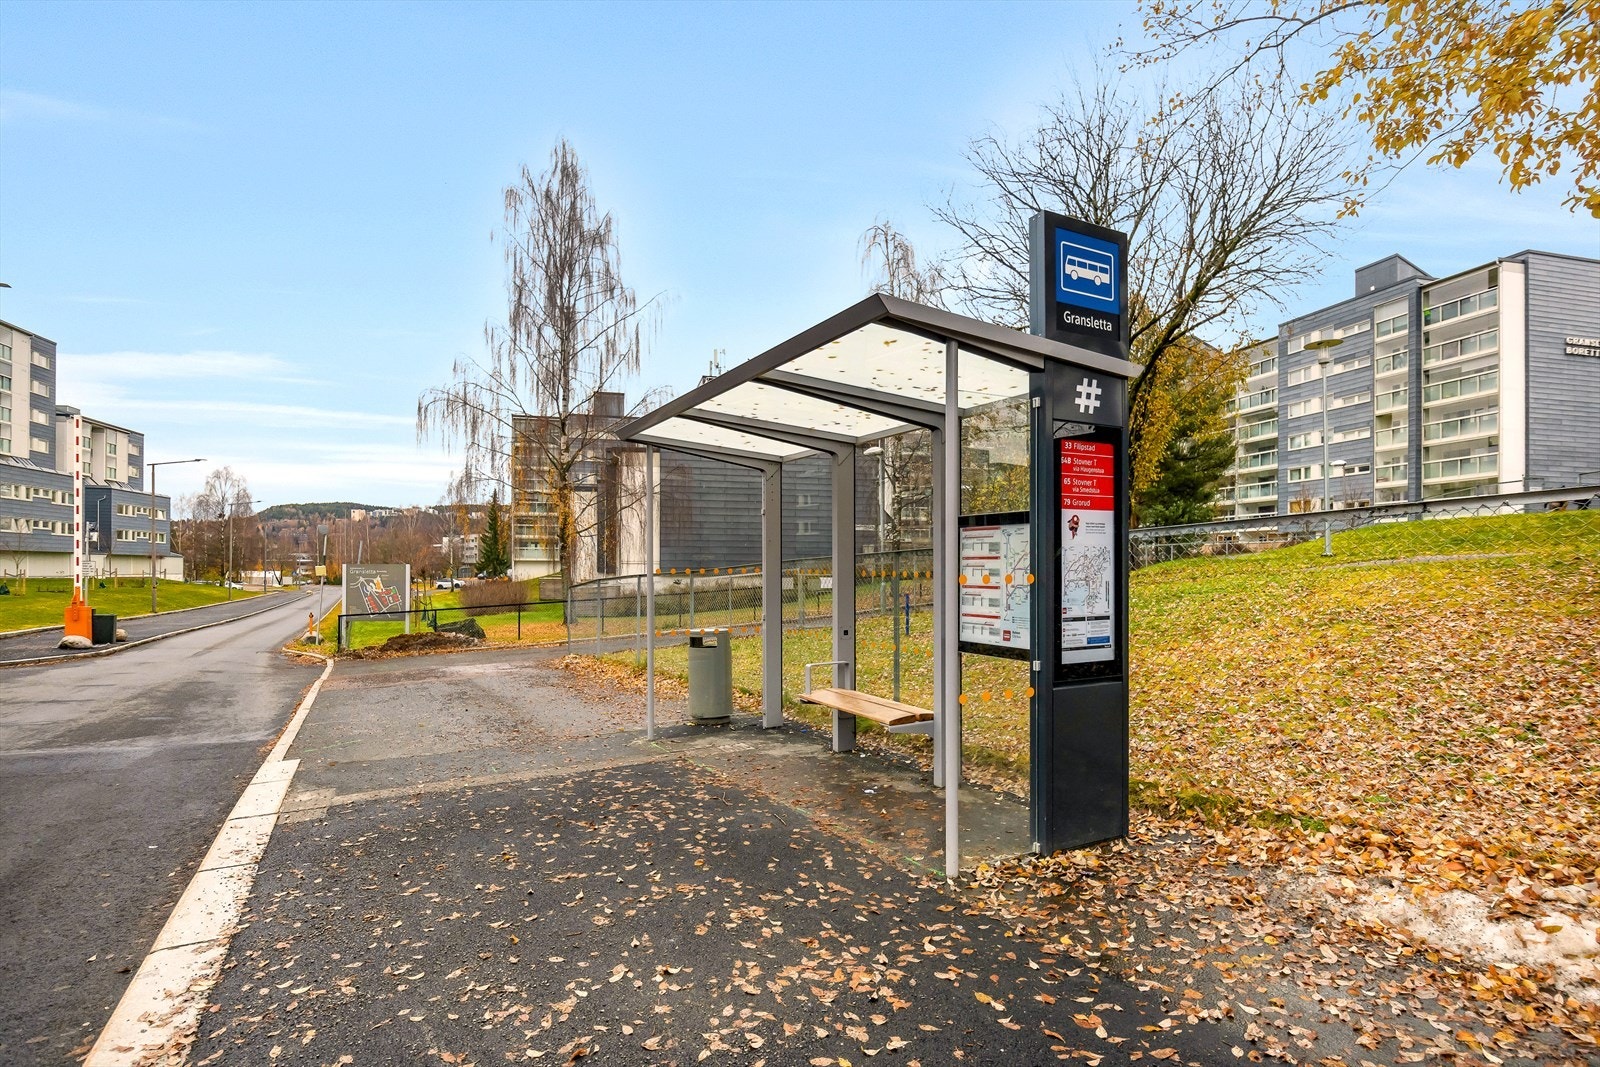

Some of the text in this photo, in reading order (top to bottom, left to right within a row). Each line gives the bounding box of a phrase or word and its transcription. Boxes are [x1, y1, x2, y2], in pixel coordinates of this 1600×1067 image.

[1063, 310, 1113, 331] Gransletta
[1064, 441, 1096, 451] 33 Filipstad
[1073, 457, 1093, 466] Stovner
[1063, 477, 1071, 485] 65
[1072, 478, 1092, 486] Stovner
[1063, 498, 1091, 507] 79 Grorud
